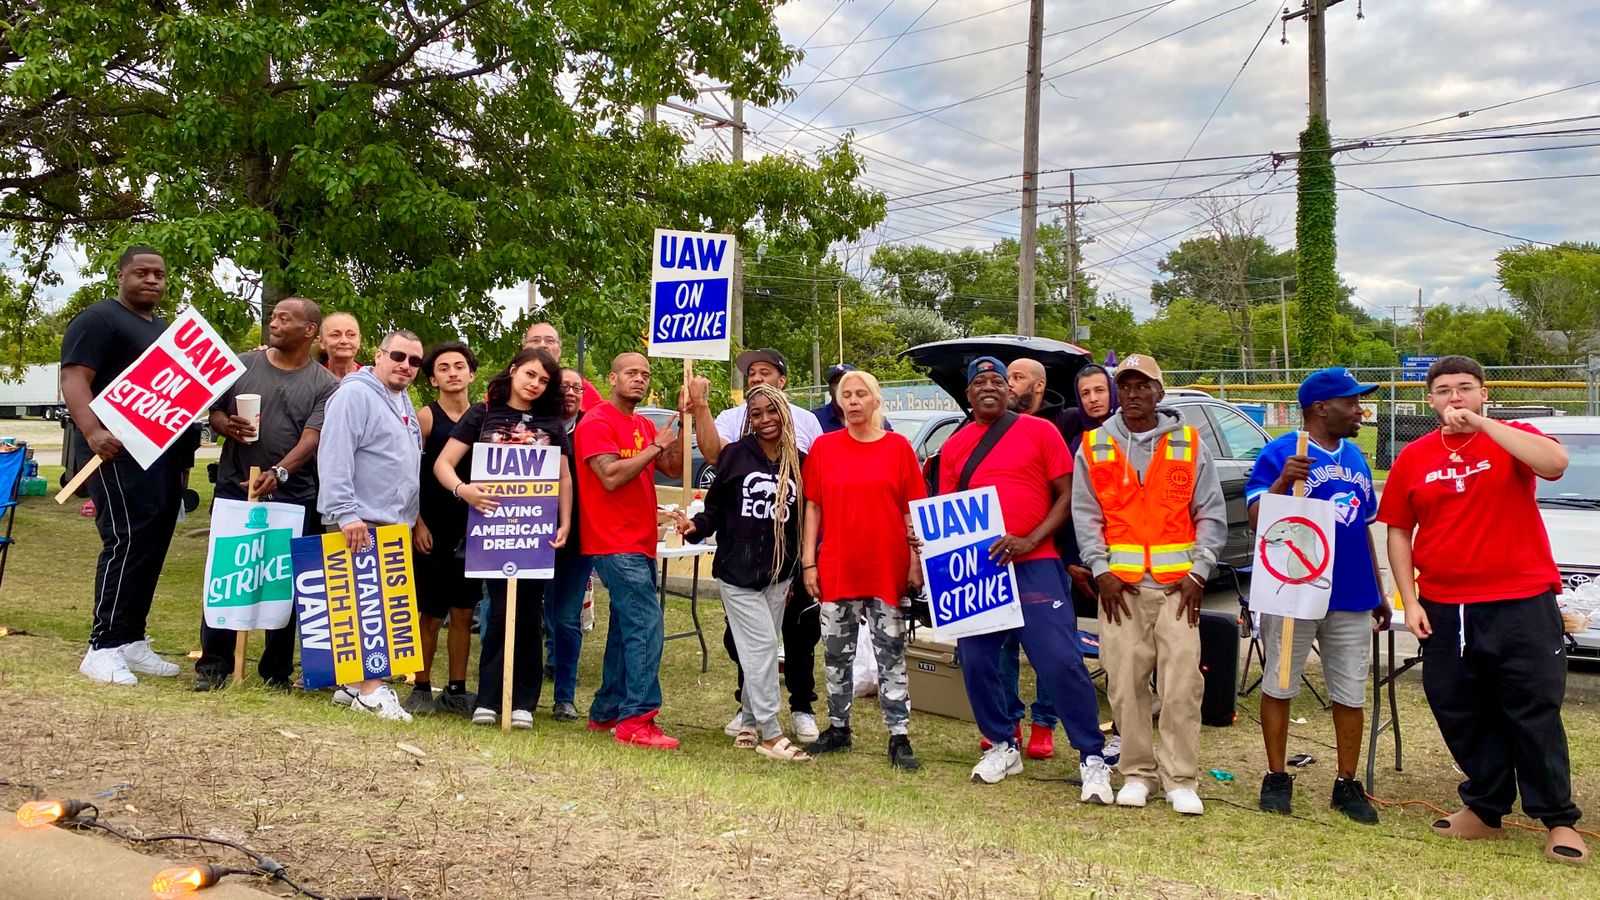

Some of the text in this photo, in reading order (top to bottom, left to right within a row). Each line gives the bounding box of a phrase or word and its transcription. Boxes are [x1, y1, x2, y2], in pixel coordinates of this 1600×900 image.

[660, 235, 727, 272] UAW
[675, 282, 704, 309] ON
[656, 310, 726, 340] STRIKE
[174, 318, 236, 386] UAW
[150, 367, 191, 400] ON
[107, 378, 193, 433] STRIKE
[486, 447, 547, 477] UAW
[1425, 459, 1491, 484] BULLS
[487, 484, 553, 495] TAND UP
[470, 523, 554, 537] AMERICAN
[917, 493, 989, 542] UAW
[234, 534, 265, 567] ON
[483, 537, 539, 551] DREAM
[208, 553, 292, 604] STRIKE
[949, 545, 978, 583] ON
[295, 569, 332, 650] UAW
[326, 549, 357, 664] WITH THE
[355, 554, 385, 651] STANDS
[383, 537, 415, 661] THIS HOME
[938, 571, 1009, 621] STRIKE
